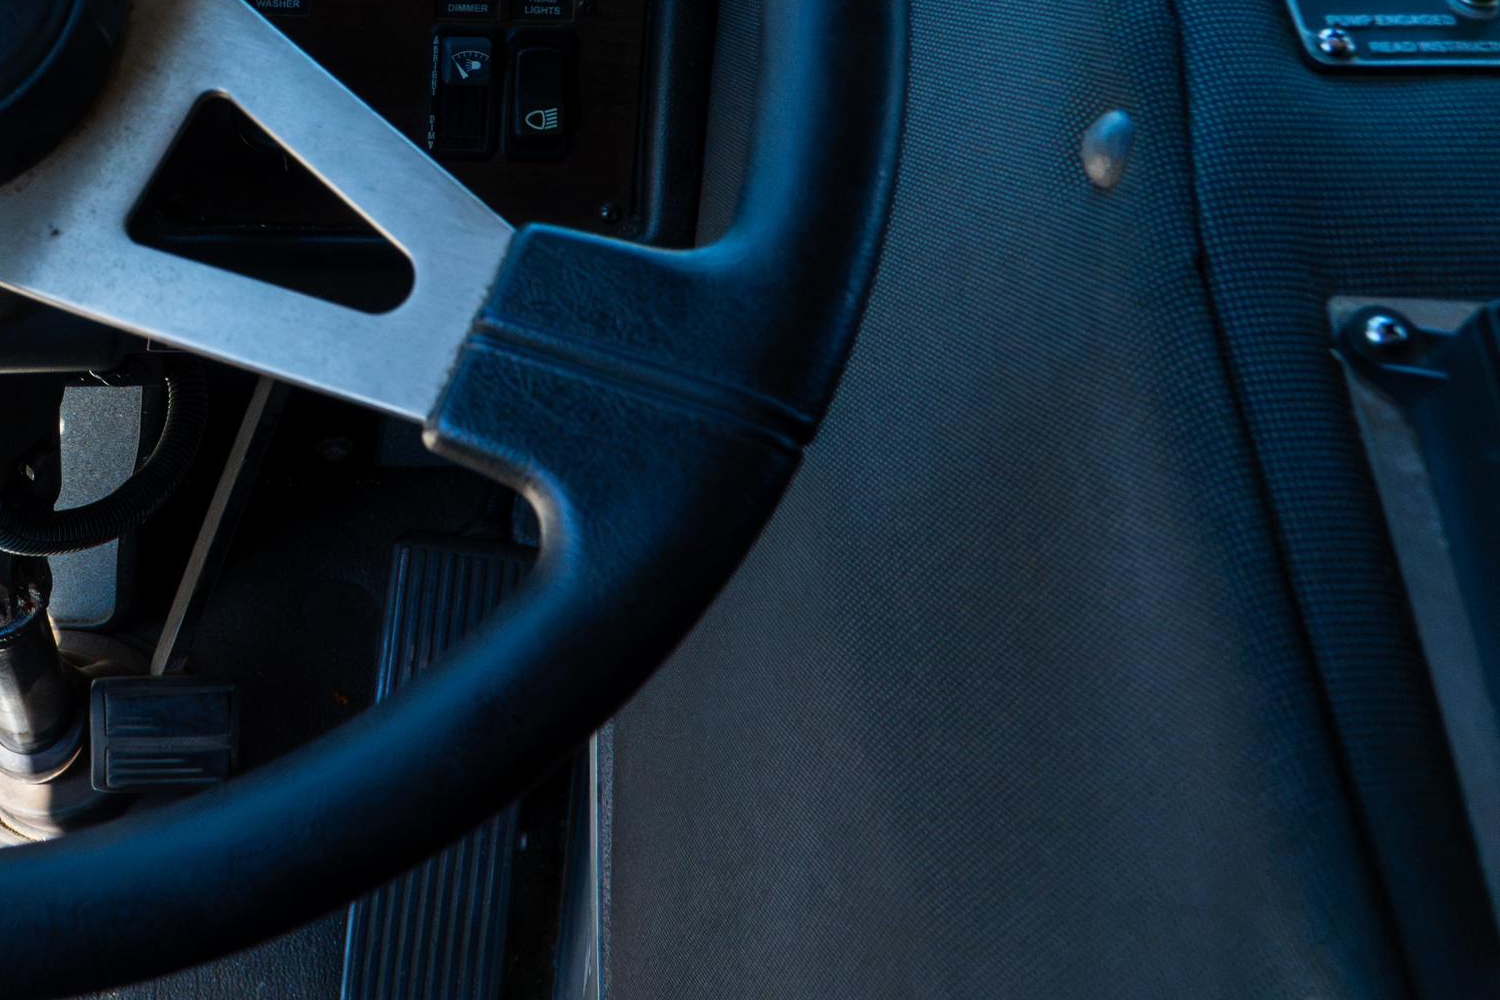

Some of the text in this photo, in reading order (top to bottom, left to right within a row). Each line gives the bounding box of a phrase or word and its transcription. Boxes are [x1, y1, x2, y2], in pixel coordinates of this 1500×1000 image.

[256, 0, 301, 9] WASHER
[447, 3, 489, 13] DIMMER
[524, 5, 561, 15] LIGHTS
[427, 114, 436, 142] DIM
